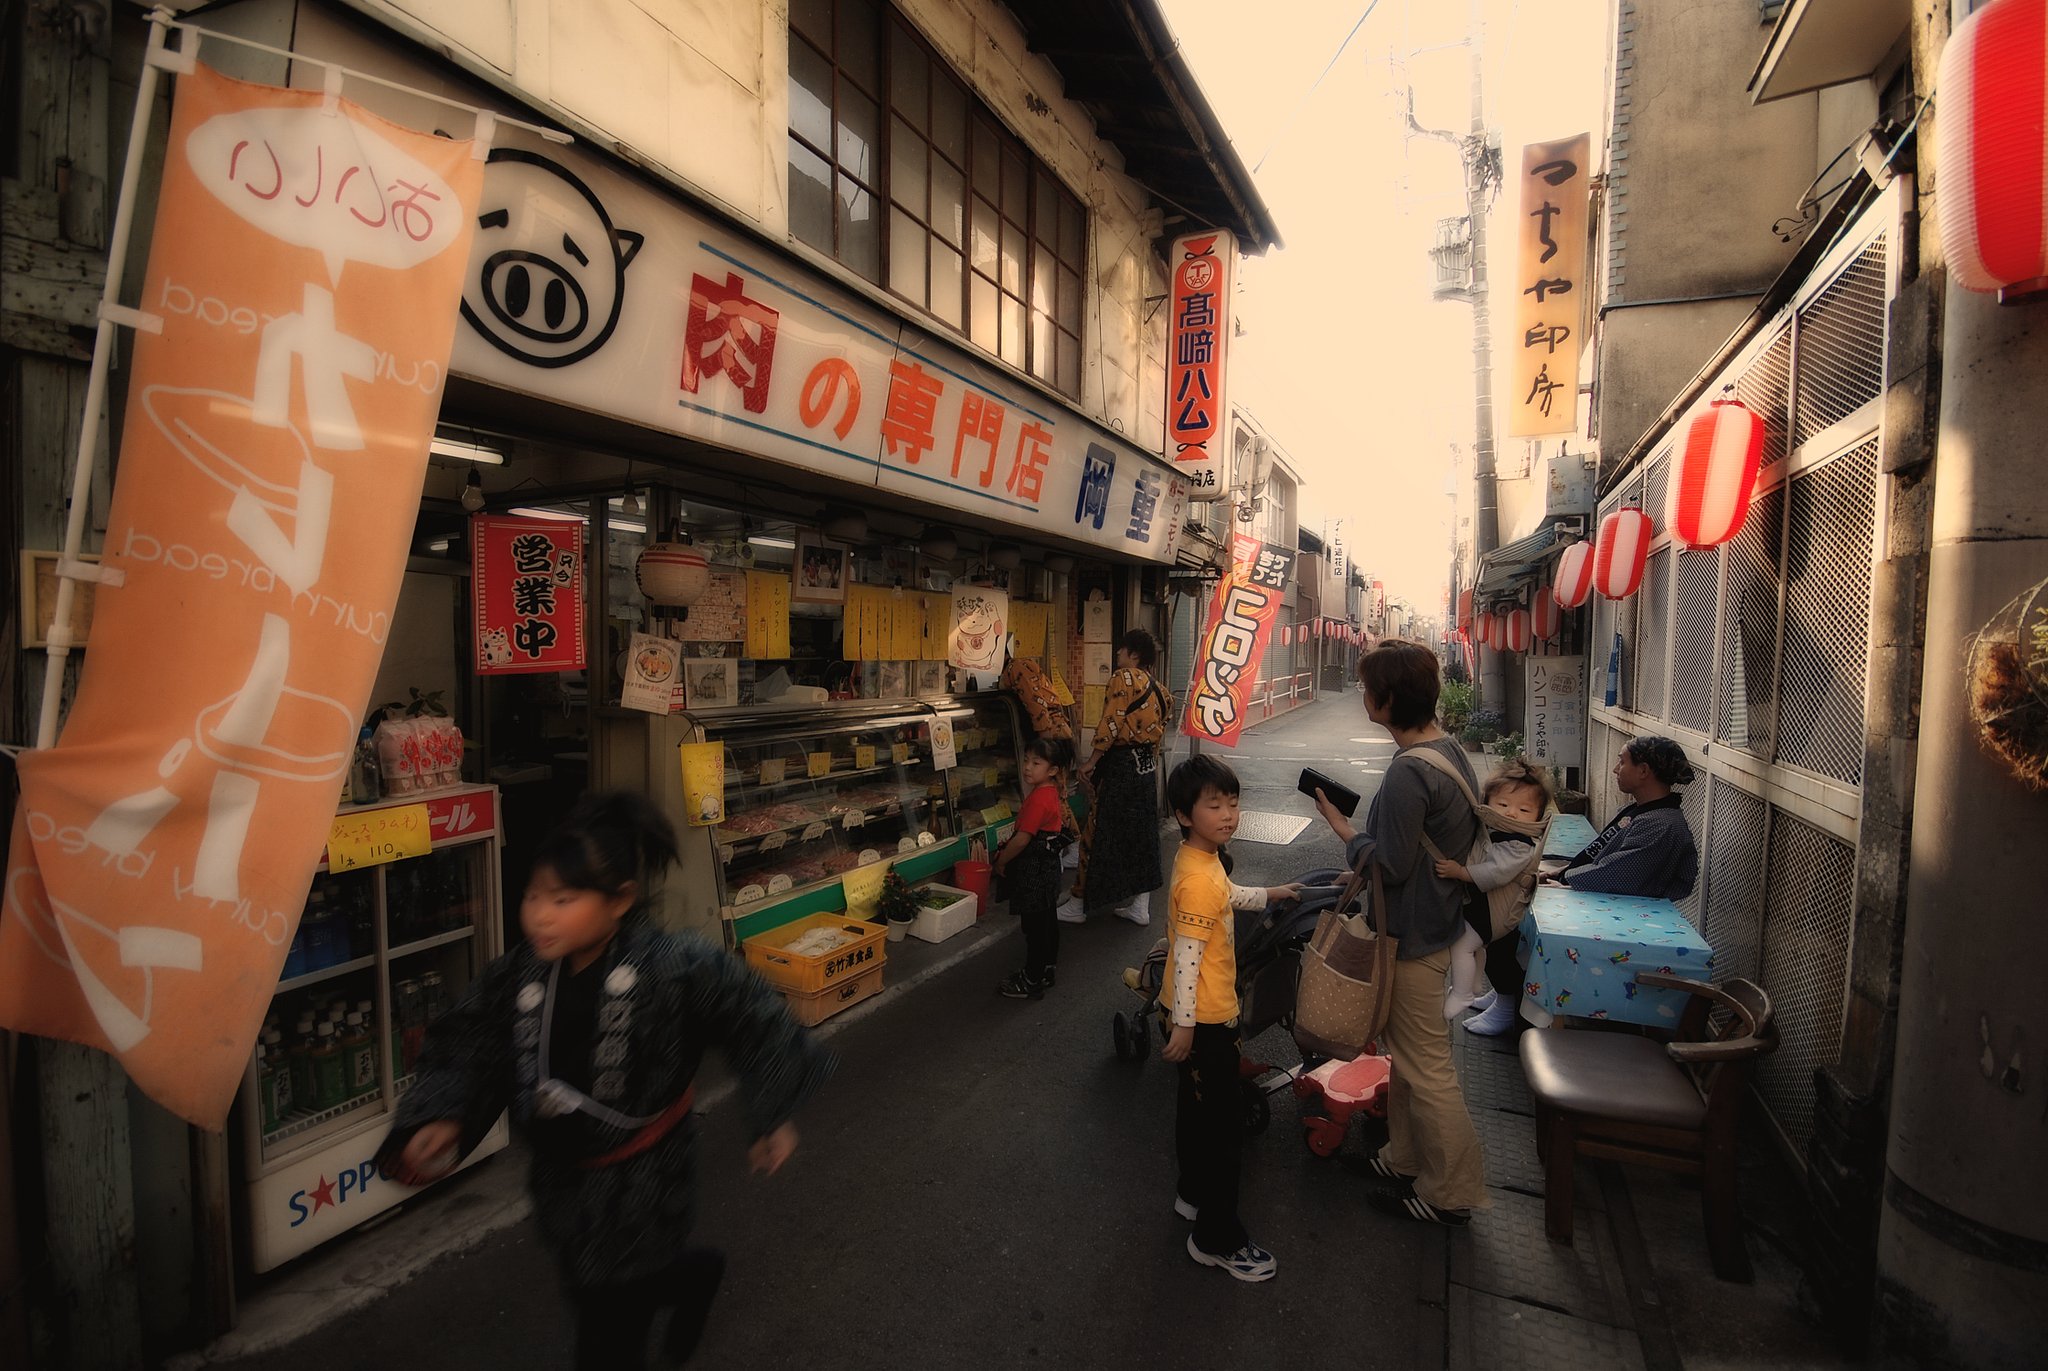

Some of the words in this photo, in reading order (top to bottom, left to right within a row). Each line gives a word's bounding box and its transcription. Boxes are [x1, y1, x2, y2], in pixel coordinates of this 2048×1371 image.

[1523, 159, 1578, 418] つちや印房
[680, 271, 1055, 503] 肉の専門店
[512, 534, 557, 658] 営業中
[1532, 665, 1547, 708] ハンコ
[1535, 712, 1547, 758] つちや印房
[428, 802, 477, 833] ール
